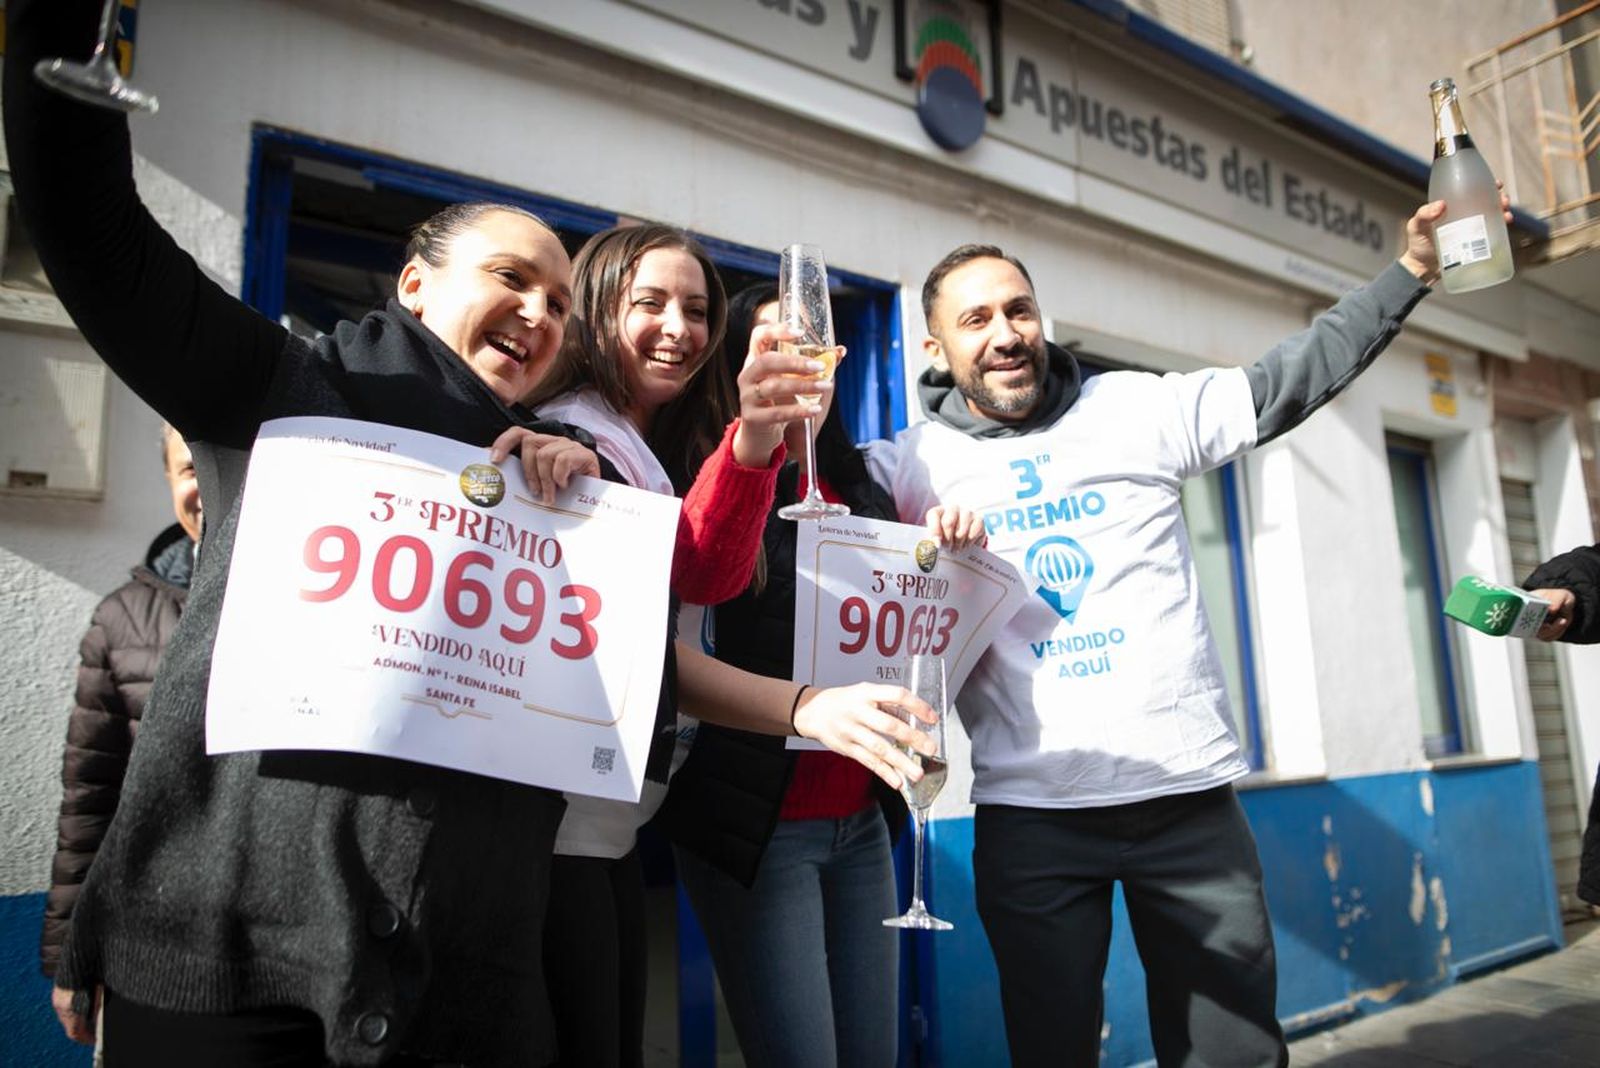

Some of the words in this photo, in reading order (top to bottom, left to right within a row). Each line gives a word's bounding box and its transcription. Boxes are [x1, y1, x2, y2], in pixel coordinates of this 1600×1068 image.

[846, 0, 879, 62] y
[1011, 56, 1209, 183] Apuestas
[1221, 148, 1273, 208] del
[1284, 174, 1386, 252] Estado
[419, 500, 563, 568] PREMIO
[983, 491, 1106, 536] PREMIO
[299, 525, 602, 660] 90693
[896, 573, 949, 600] PREMIO
[372, 624, 473, 661] VENDIDO
[478, 647, 526, 678] AQUÍ
[839, 596, 959, 658] 90693
[1031, 628, 1125, 658] VENDIDO
[373, 657, 425, 675] ADMON.
[456, 673, 488, 691] REINA
[489, 683, 522, 701] ISABEL
[1058, 651, 1112, 679] AQUÍ
[425, 687, 461, 705] SANTA
[463, 697, 476, 708] FE
